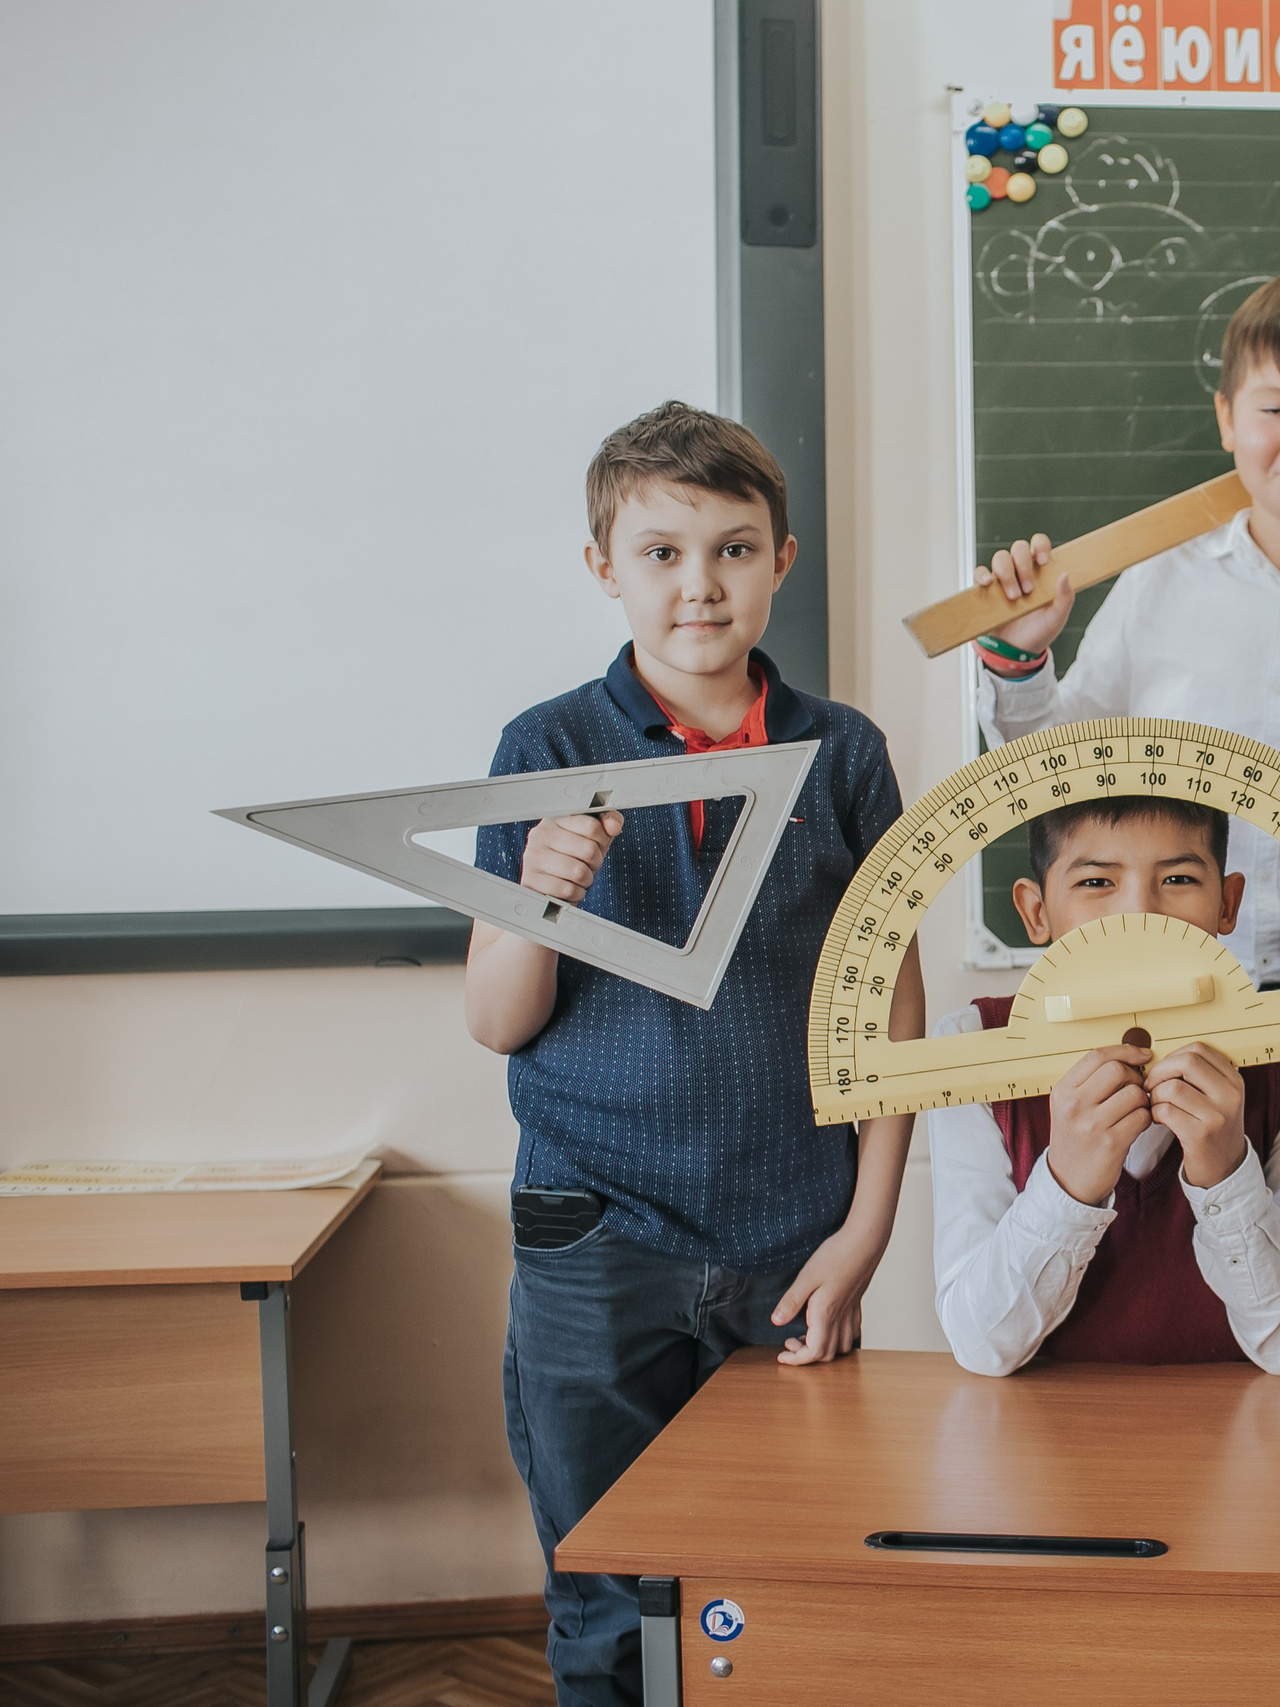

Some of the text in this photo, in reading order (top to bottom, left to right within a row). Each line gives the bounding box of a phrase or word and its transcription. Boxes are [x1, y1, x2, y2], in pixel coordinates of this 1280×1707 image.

[1092, 744, 1114, 760] 90
[1144, 745, 1165, 758] 80
[1195, 749, 1215, 766] 70
[1039, 753, 1067, 772] 100
[992, 771, 1020, 793] 110
[1096, 772, 1117, 787] 90
[1139, 772, 1167, 786] 100
[1242, 765, 1264, 783] 60
[1050, 781, 1072, 798] 80
[1186, 776, 1212, 794] 110
[949, 796, 976, 821] 120
[1006, 797, 1029, 816] 70
[1229, 790, 1257, 810] 120
[967, 821, 989, 842] 60
[911, 829, 937, 857] 130
[933, 852, 954, 873] 50
[880, 870, 904, 897] 140
[905, 888, 925, 911] 40
[857, 916, 877, 943] 150
[883, 930, 902, 952] 30
[842, 965, 859, 992] 160
[869, 975, 886, 997] 20
[836, 1016, 850, 1044] 170
[864, 1021, 878, 1041] 10
[837, 1068, 852, 1095] 180
[865, 1074, 879, 1083] 0
[941, 1090, 952, 1098] 10
[1007, 1082, 1017, 1090] 15
